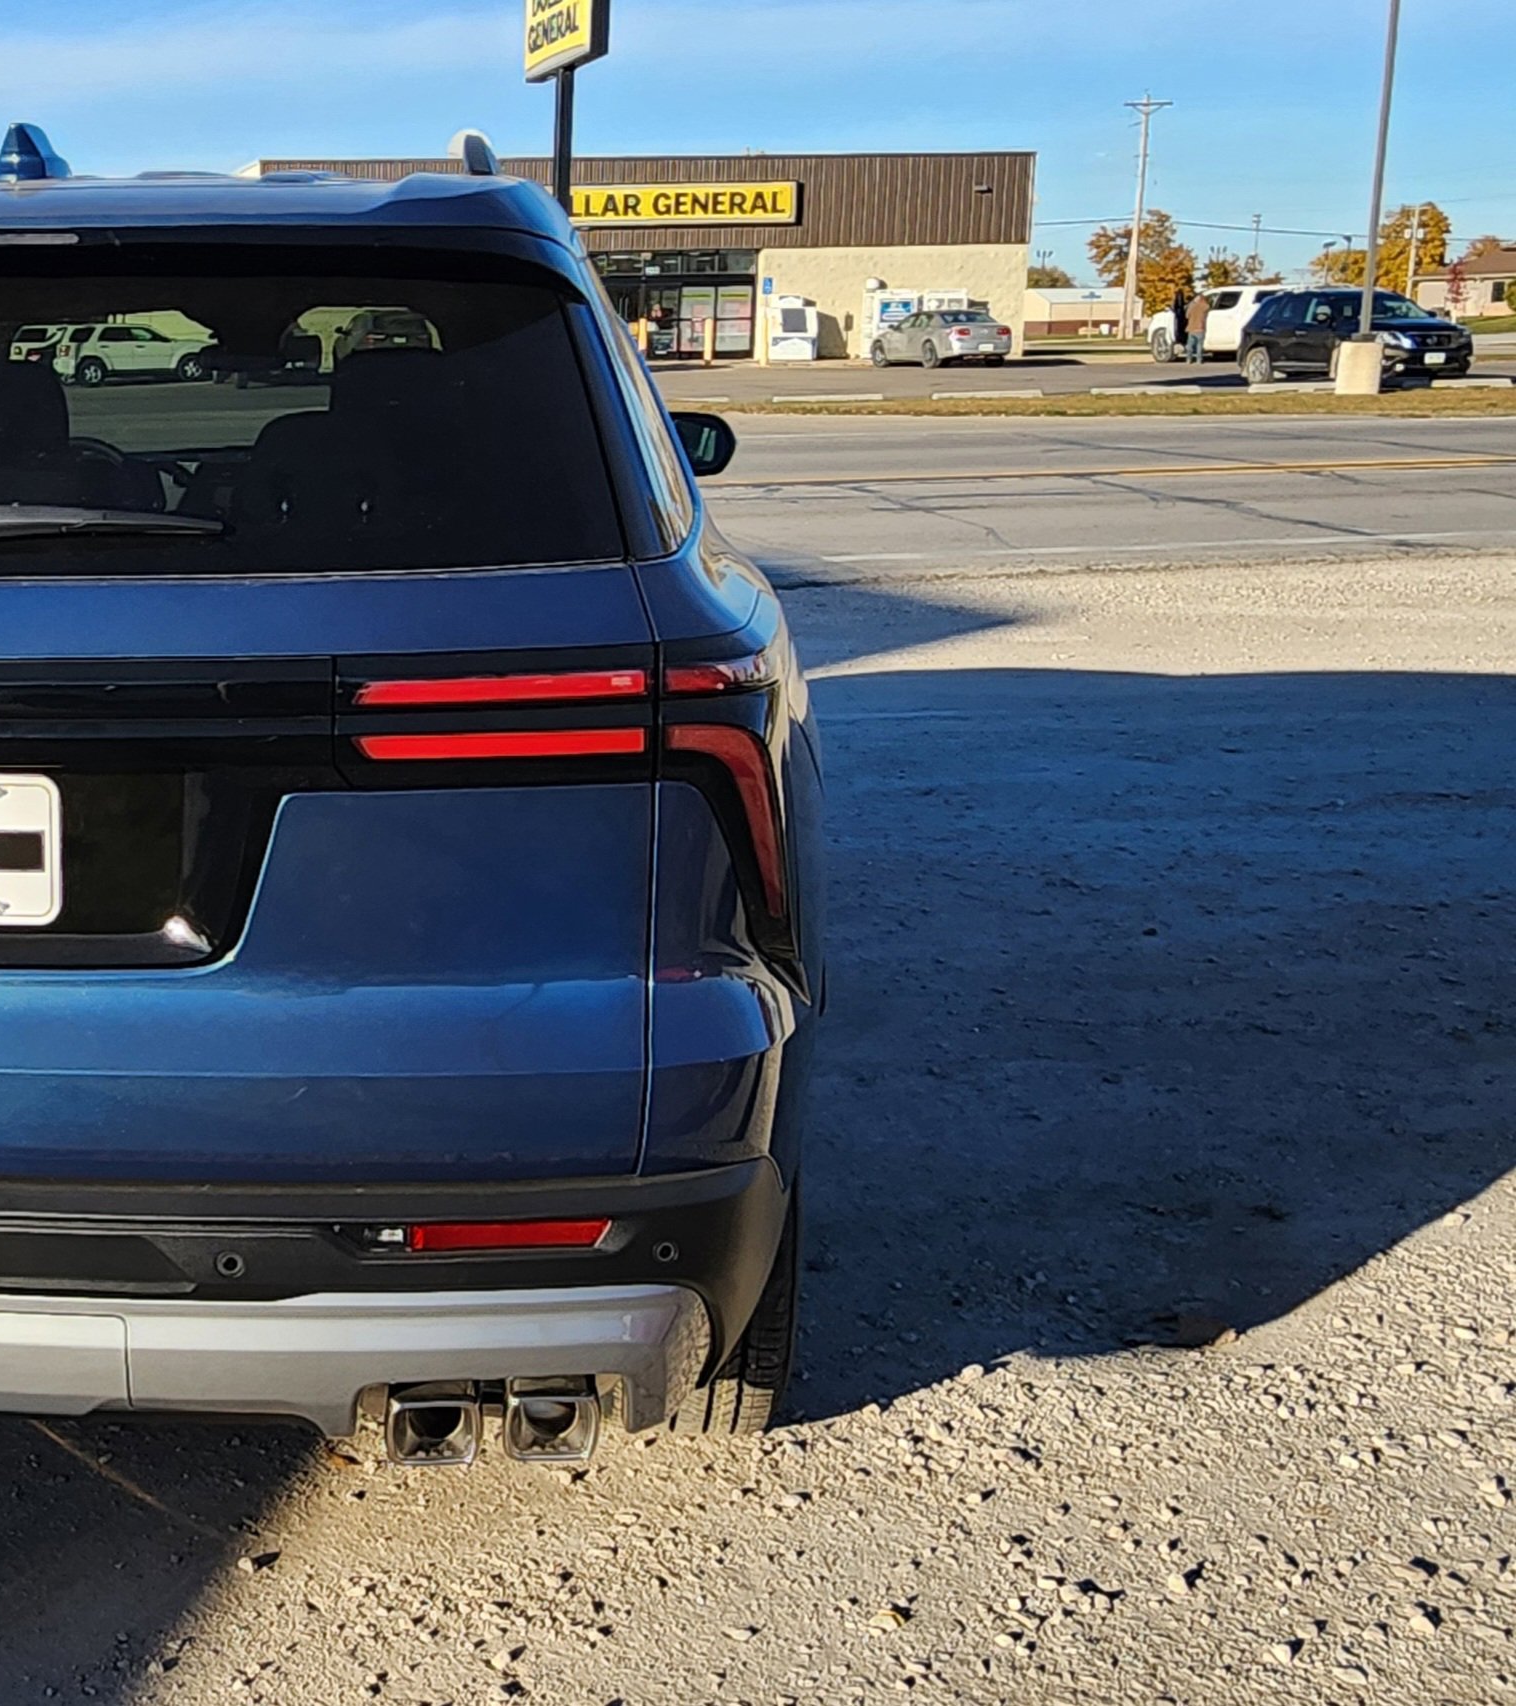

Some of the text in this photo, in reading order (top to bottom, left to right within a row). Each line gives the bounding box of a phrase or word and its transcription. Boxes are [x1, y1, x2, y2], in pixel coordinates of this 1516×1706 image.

[528, 2, 579, 54] GENERAL
[569, 191, 785, 217] LLAR GENERAL
